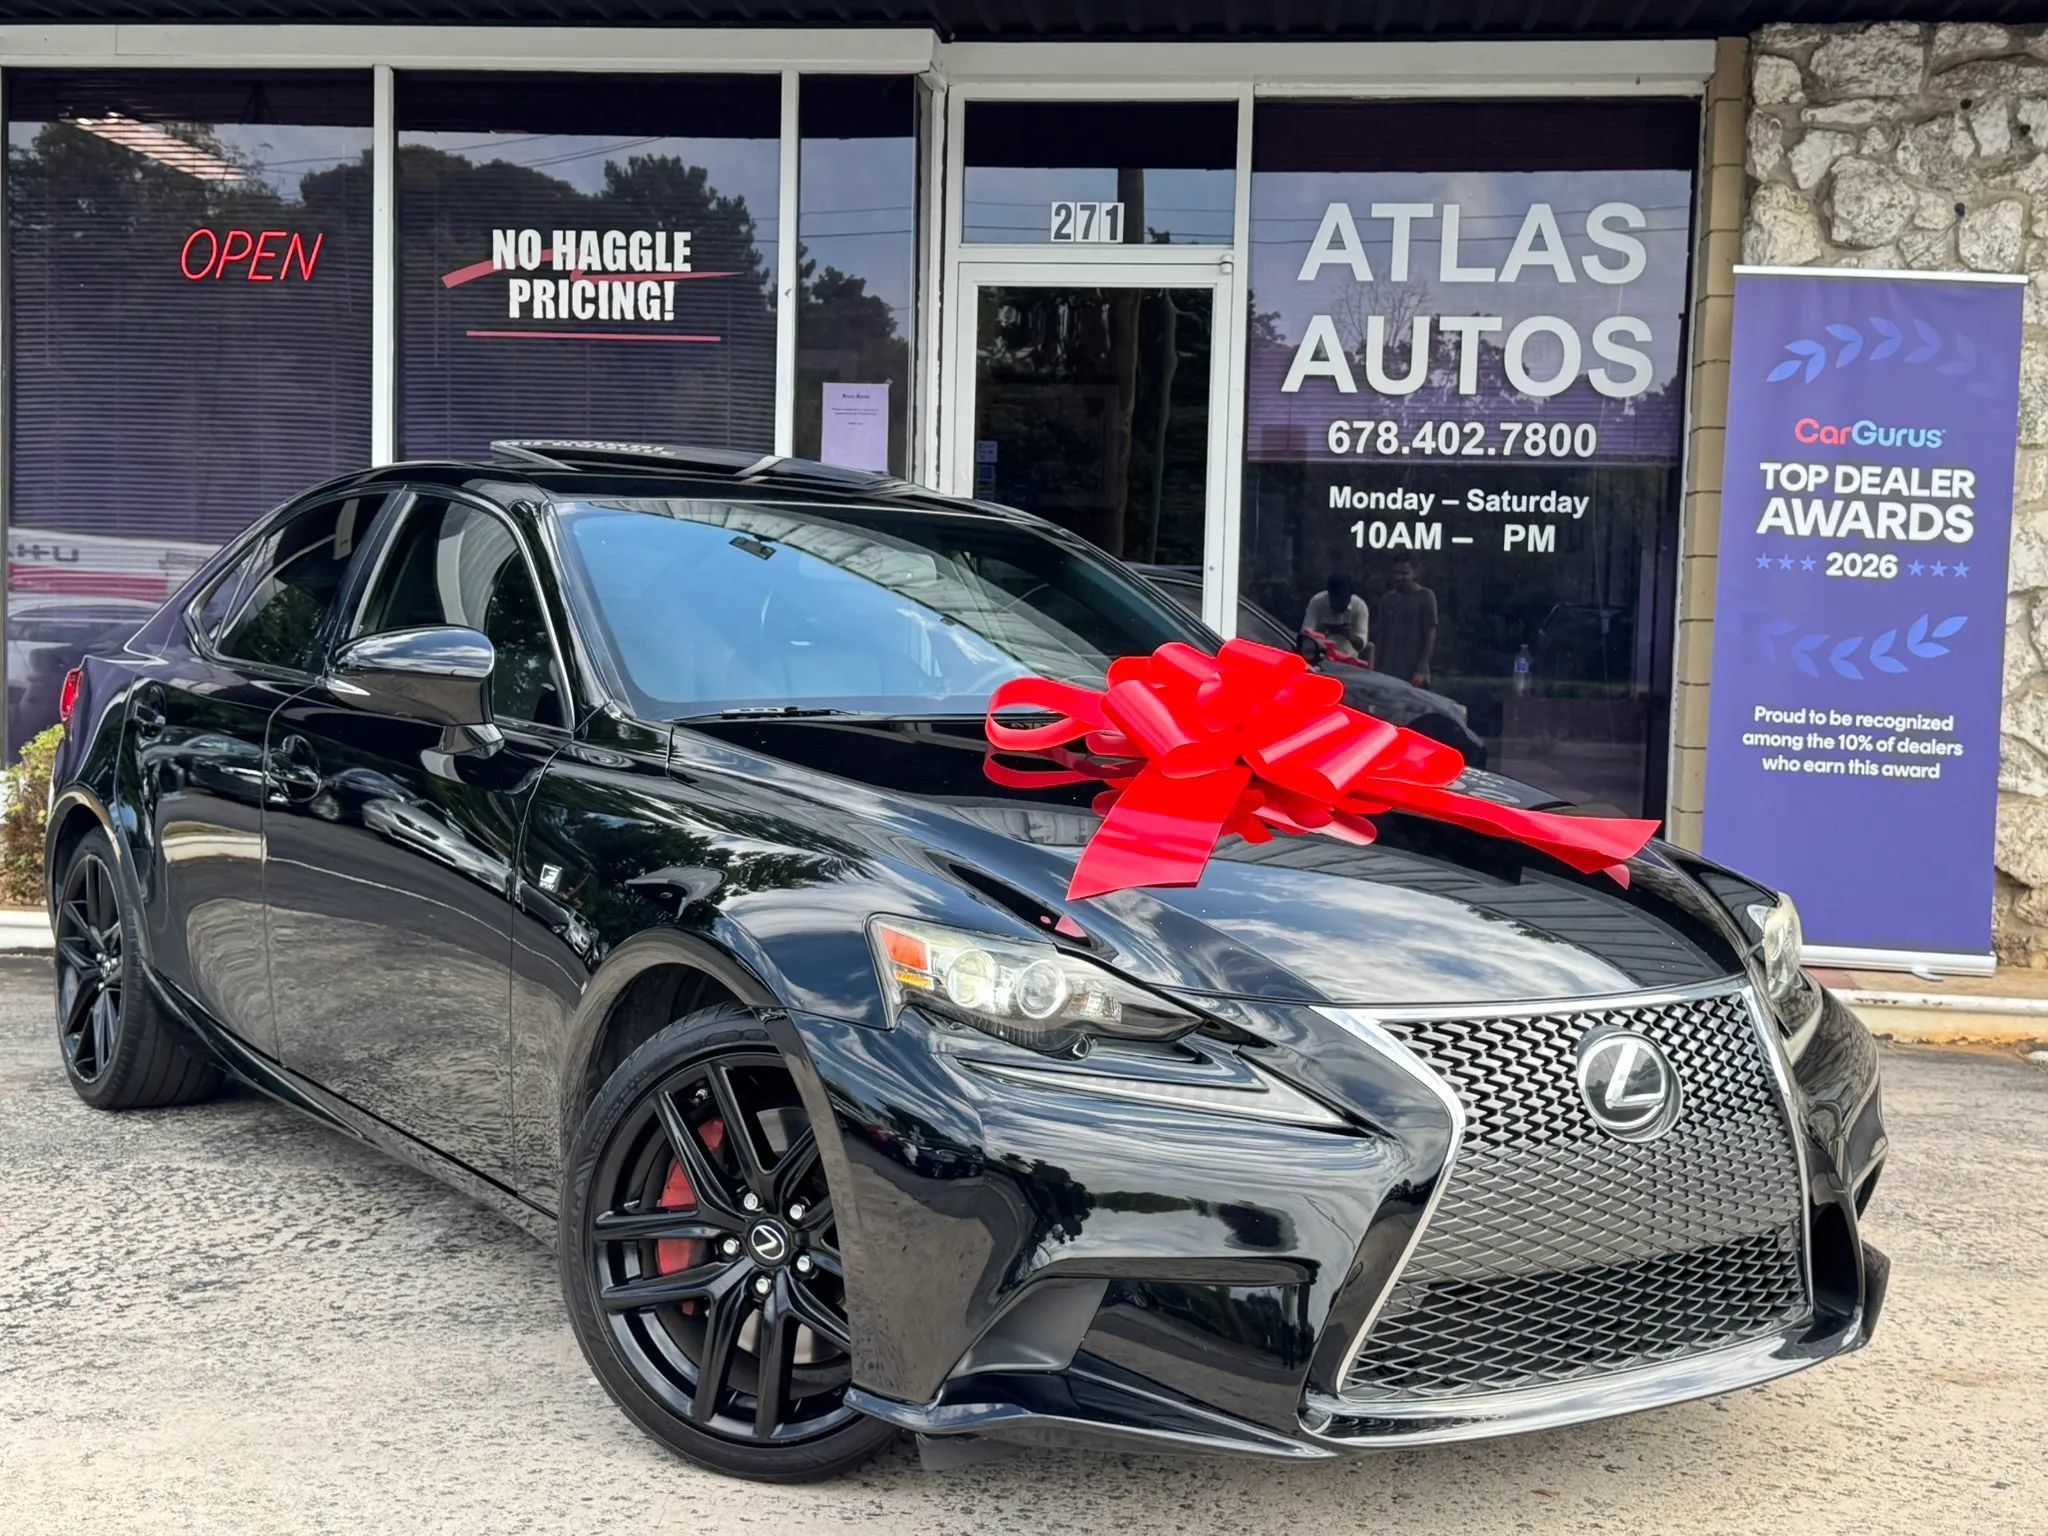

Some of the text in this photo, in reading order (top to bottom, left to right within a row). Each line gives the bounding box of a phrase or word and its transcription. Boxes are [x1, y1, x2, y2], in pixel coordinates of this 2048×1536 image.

[1053, 203, 1119, 241] 271
[181, 228, 324, 283] OPEN
[492, 229, 692, 272] NO HAGGLE
[1297, 203, 1647, 284] ATLAS
[508, 278, 675, 321] PRICING!
[1281, 315, 1653, 398] AUTOS
[1328, 420, 1598, 457] 678.402.7800
[1794, 417, 1944, 449] CarGurus
[1759, 462, 1976, 498] TOP DEALER
[1329, 485, 1435, 516] Monday
[1466, 488, 1590, 519] Saturday
[1350, 520, 1442, 551] 10AM
[1503, 523, 1556, 553] PM
[1756, 497, 1975, 544] AWARDS
[1825, 551, 1898, 579] 2026
[1754, 705, 1954, 733] Proud to be recognized
[1742, 731, 1964, 757] among the 10% of dealers
[1761, 754, 1941, 780] who earn this award
